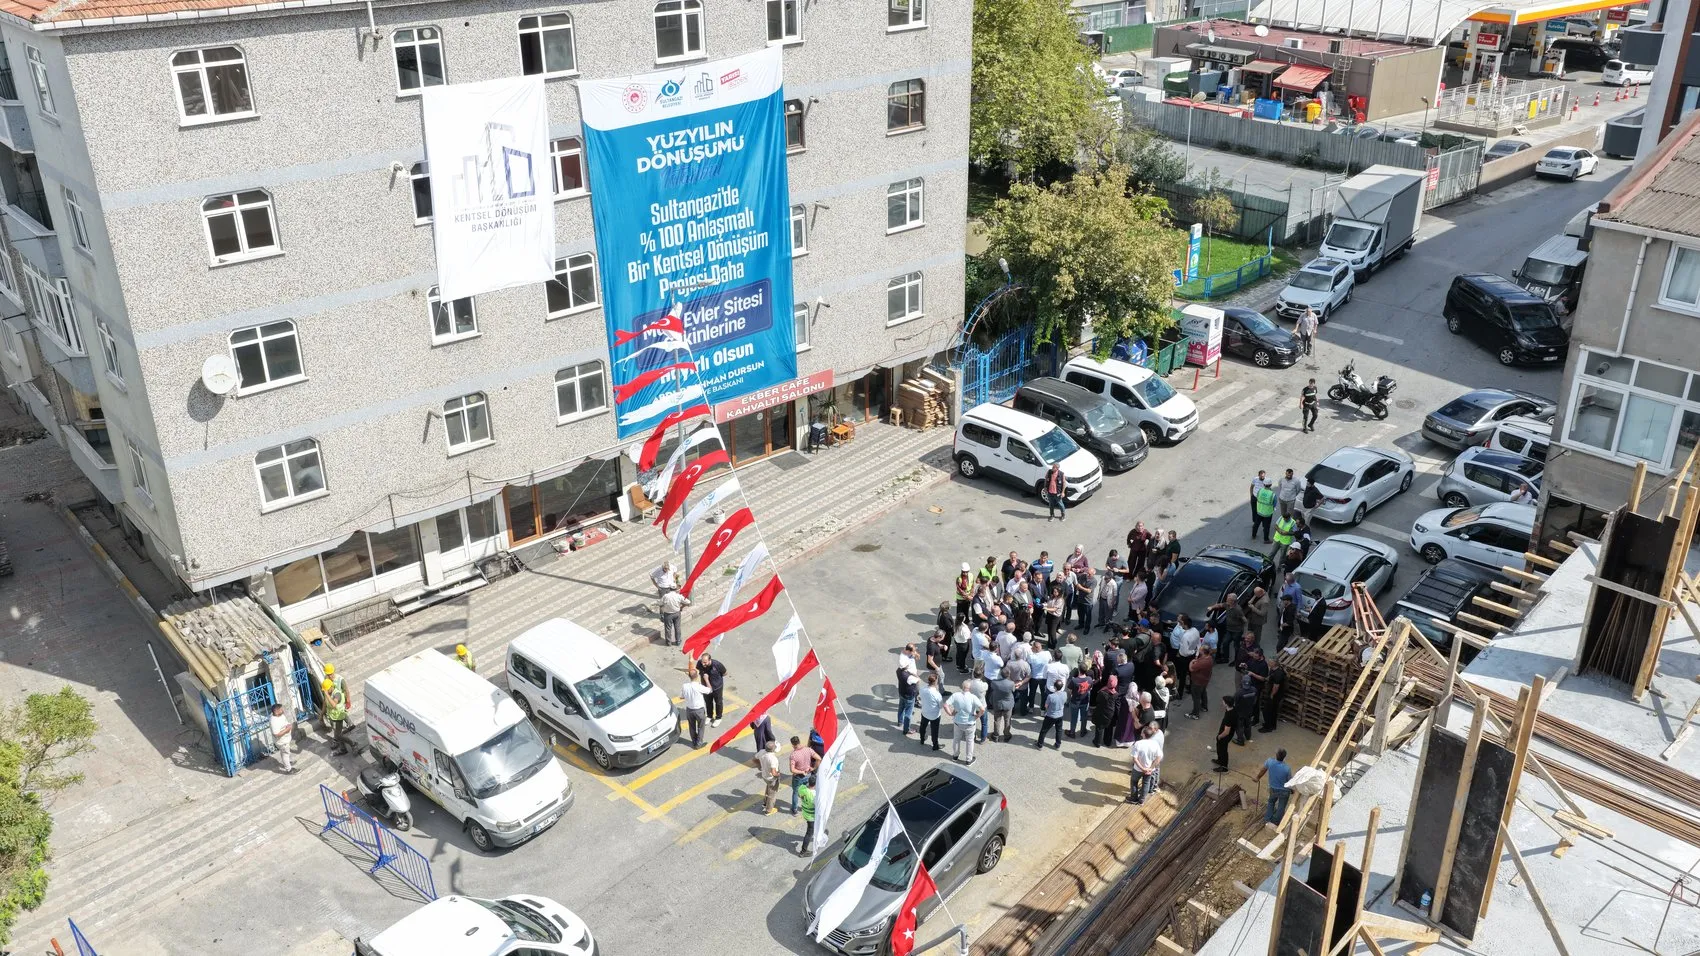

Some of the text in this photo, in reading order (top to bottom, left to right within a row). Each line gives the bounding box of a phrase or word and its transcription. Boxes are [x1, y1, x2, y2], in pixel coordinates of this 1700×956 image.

[454, 210, 493, 223] KENTSEL
[495, 204, 537, 218] DÖNÜŞÜM
[650, 185, 740, 225] Sultangazi'de
[471, 217, 522, 232] BAŞKANLIĞI
[640, 206, 755, 254] % 100 Anlaşmalı
[628, 230, 769, 284] Bir Kentsel Dönüşüm
[711, 261, 745, 285] Daha
[684, 289, 763, 328] Evler Sitesi
[713, 343, 754, 366] Olsun
[728, 360, 765, 379] DURSUN
[726, 382, 825, 419] KAHVALTI SALONU
[741, 377, 810, 405] EKBER CAFE
